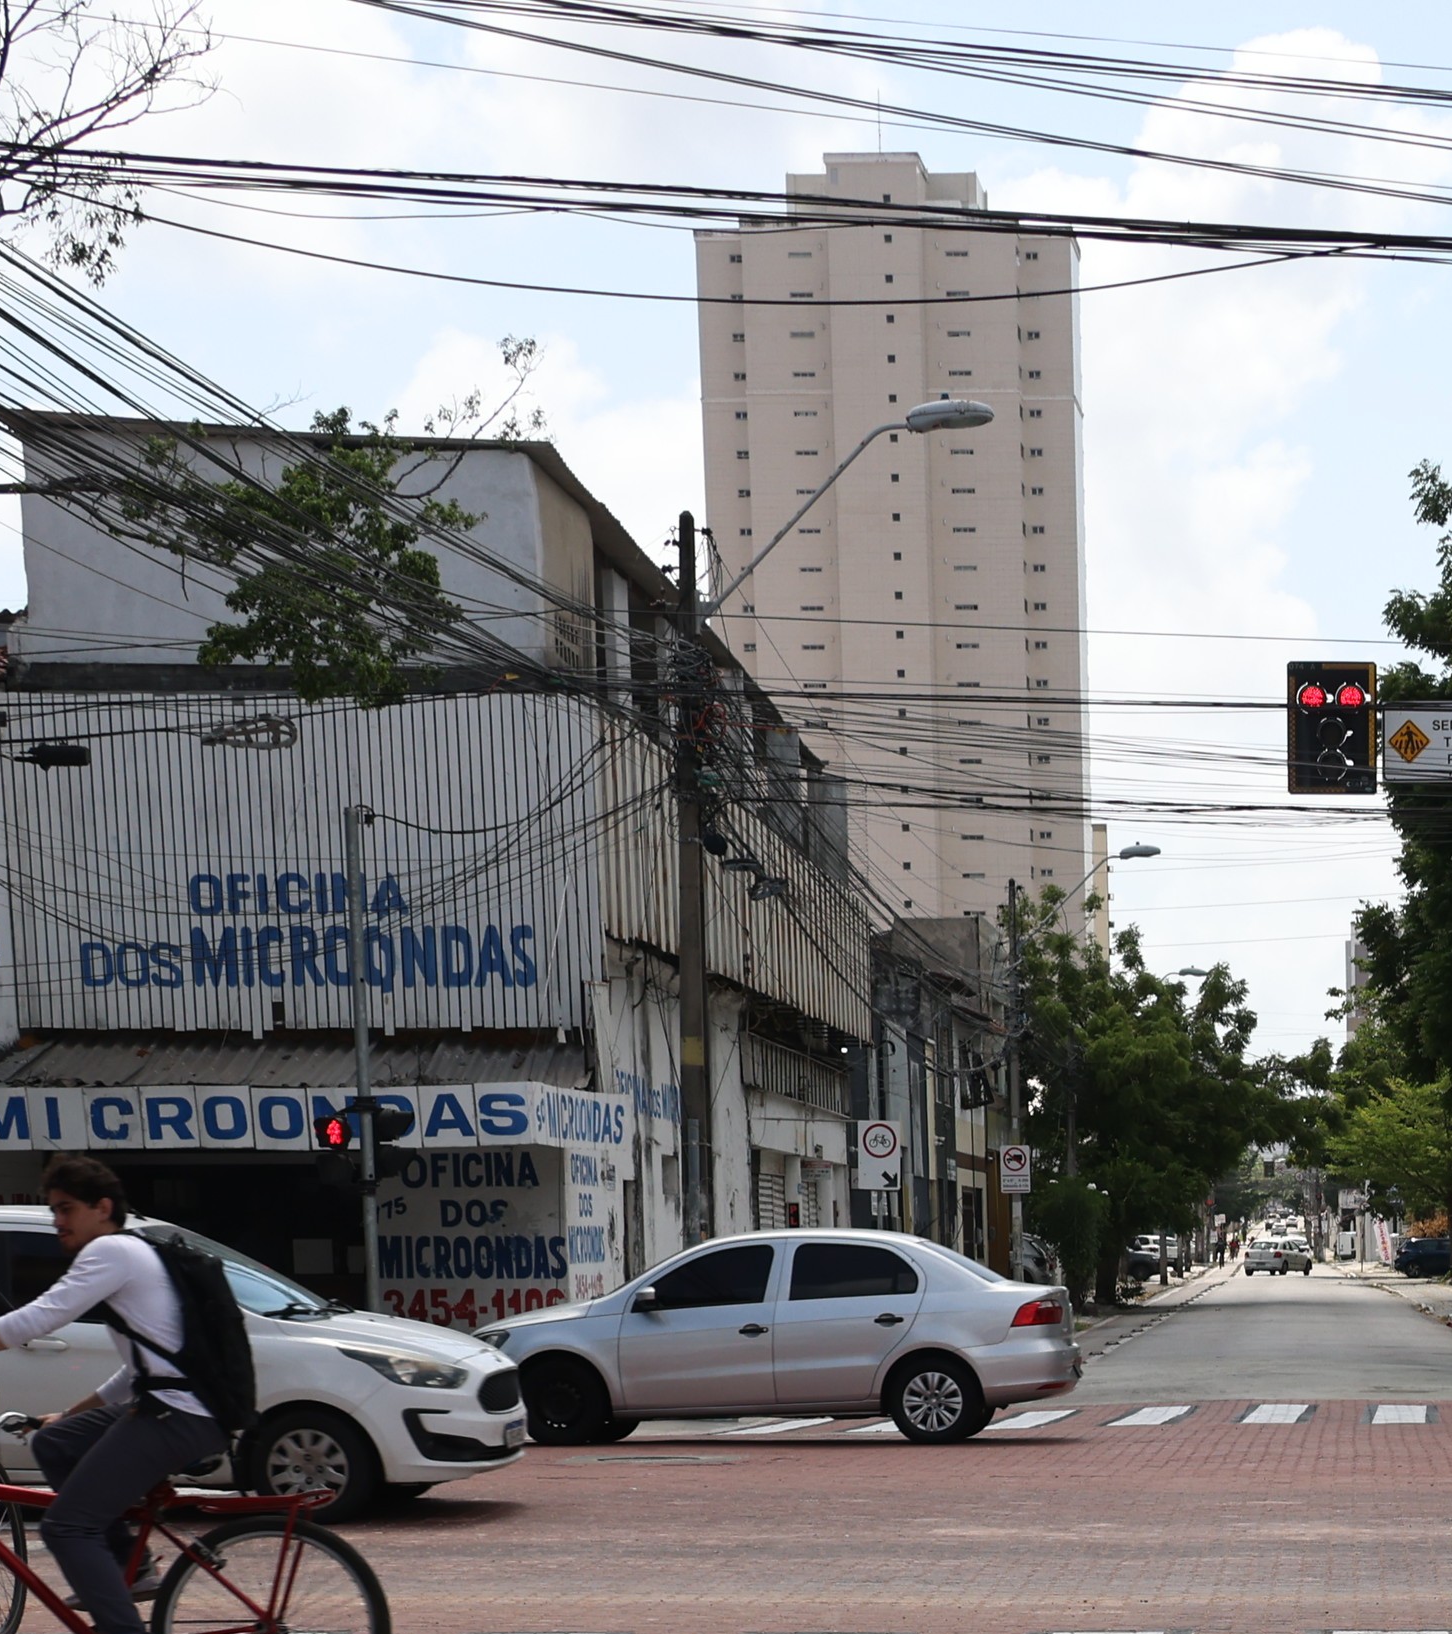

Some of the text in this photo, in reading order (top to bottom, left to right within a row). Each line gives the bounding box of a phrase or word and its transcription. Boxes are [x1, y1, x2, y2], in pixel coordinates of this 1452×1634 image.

[189, 872, 409, 917] OFICINA
[81, 925, 536, 991] DOS MICROONDAS
[547, 1092, 625, 1145] MICROONDAS
[402, 1151, 540, 1189] OFICINA
[571, 1153, 598, 1187] OFICINA
[440, 1199, 508, 1228] DOS
[579, 1193, 593, 1219] DOS
[379, 1235, 568, 1280] MICROONDAS
[568, 1225, 605, 1265] MICROONDAS
